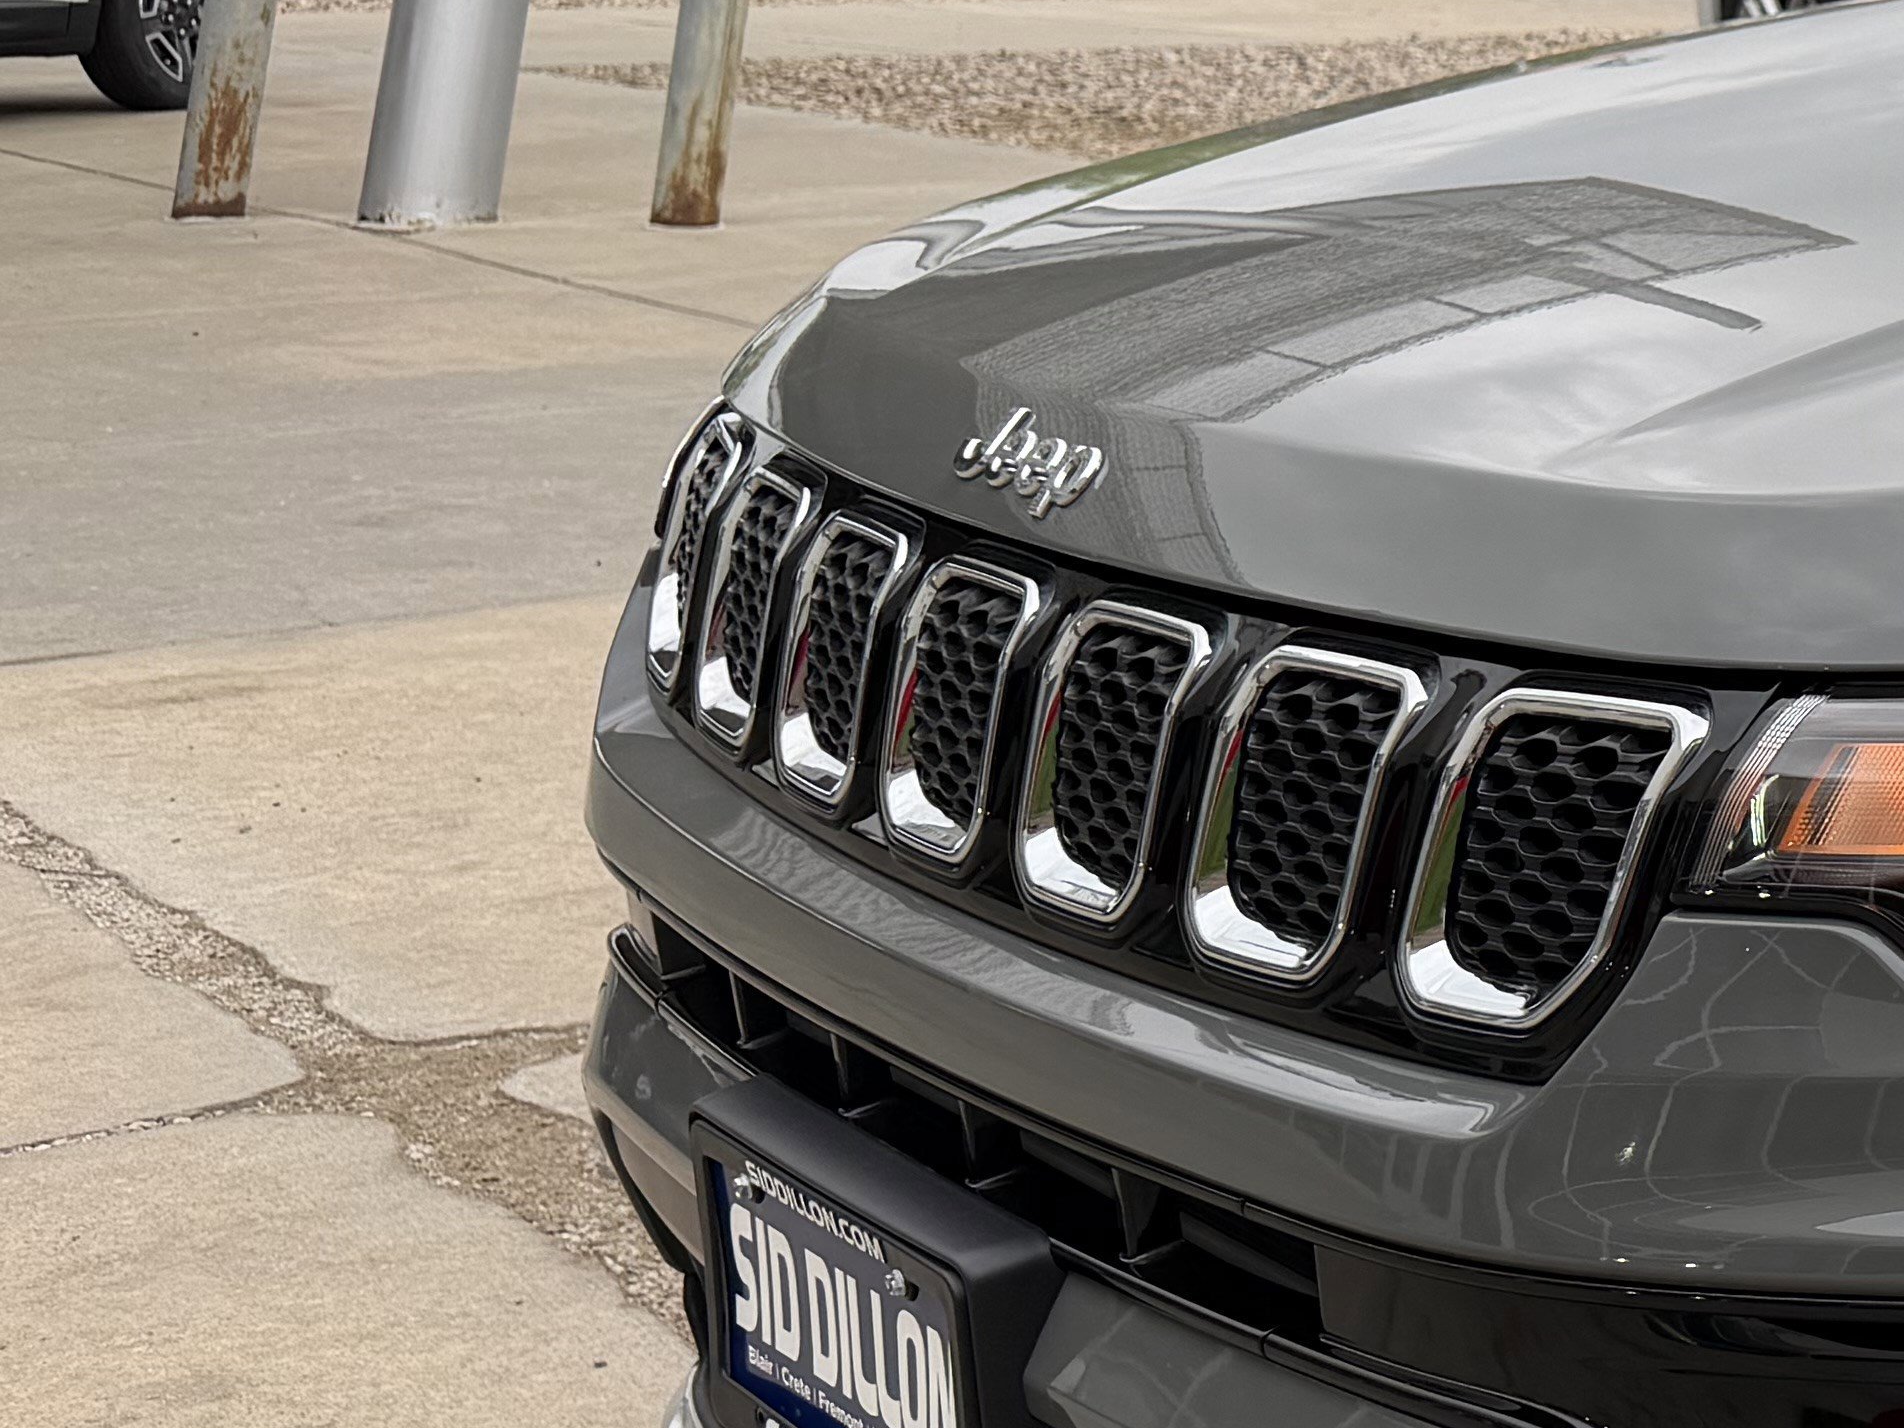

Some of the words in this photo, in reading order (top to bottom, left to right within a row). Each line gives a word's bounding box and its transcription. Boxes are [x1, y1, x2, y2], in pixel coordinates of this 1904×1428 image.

[953, 407, 1109, 519] Jeep
[744, 1159, 887, 1264] SIDDILLON.COM
[730, 1202, 801, 1362] SID
